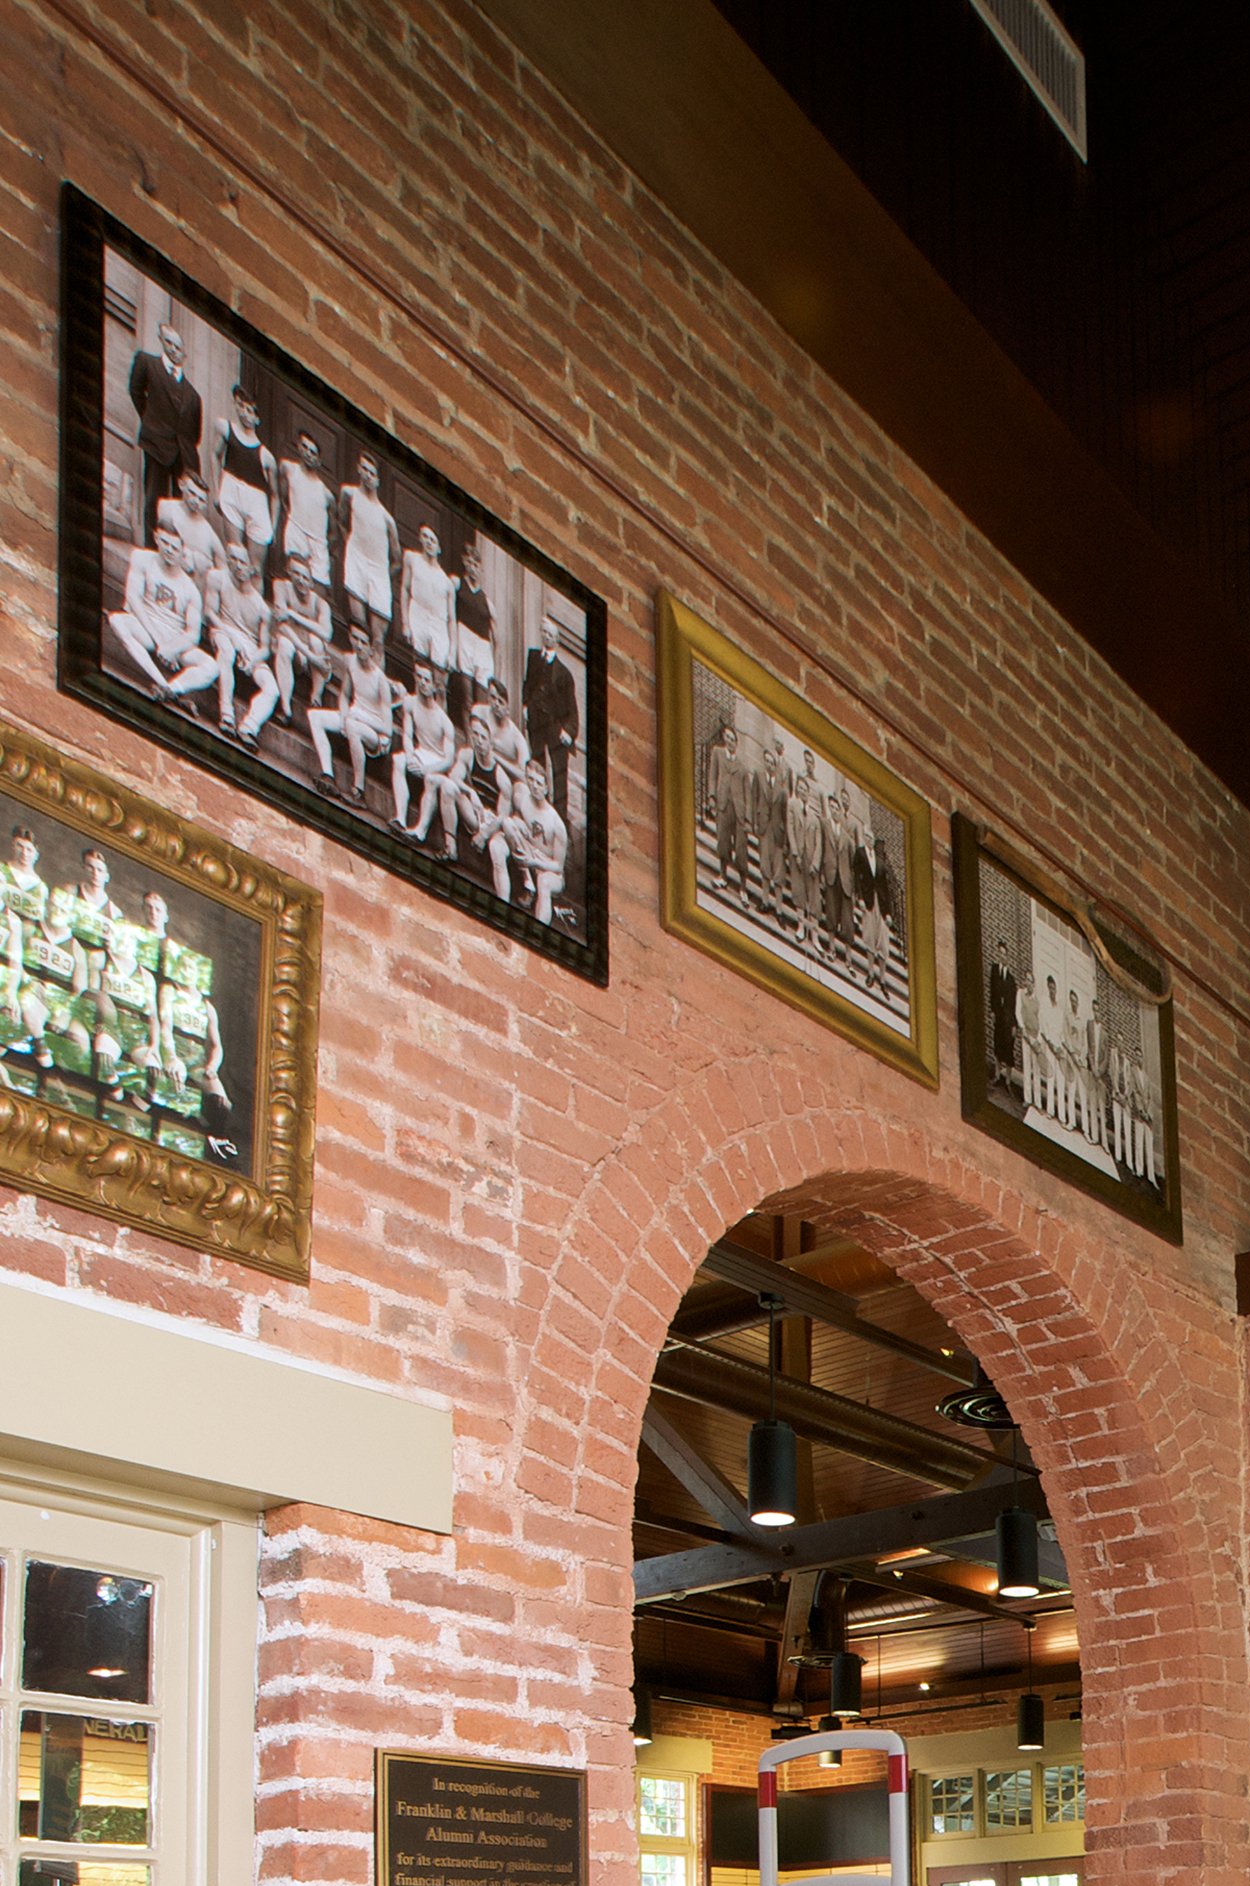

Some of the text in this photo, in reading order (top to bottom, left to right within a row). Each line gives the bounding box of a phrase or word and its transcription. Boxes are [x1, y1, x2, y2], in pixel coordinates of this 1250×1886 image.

[432, 1777, 446, 1791] In
[448, 1782, 508, 1797] recognition
[397, 1800, 573, 1831] Franklin & Marshall College
[426, 1826, 548, 1848] Alumni Association
[397, 1852, 415, 1866] for
[416, 1853, 432, 1867] its
[433, 1856, 504, 1873] extraordinary
